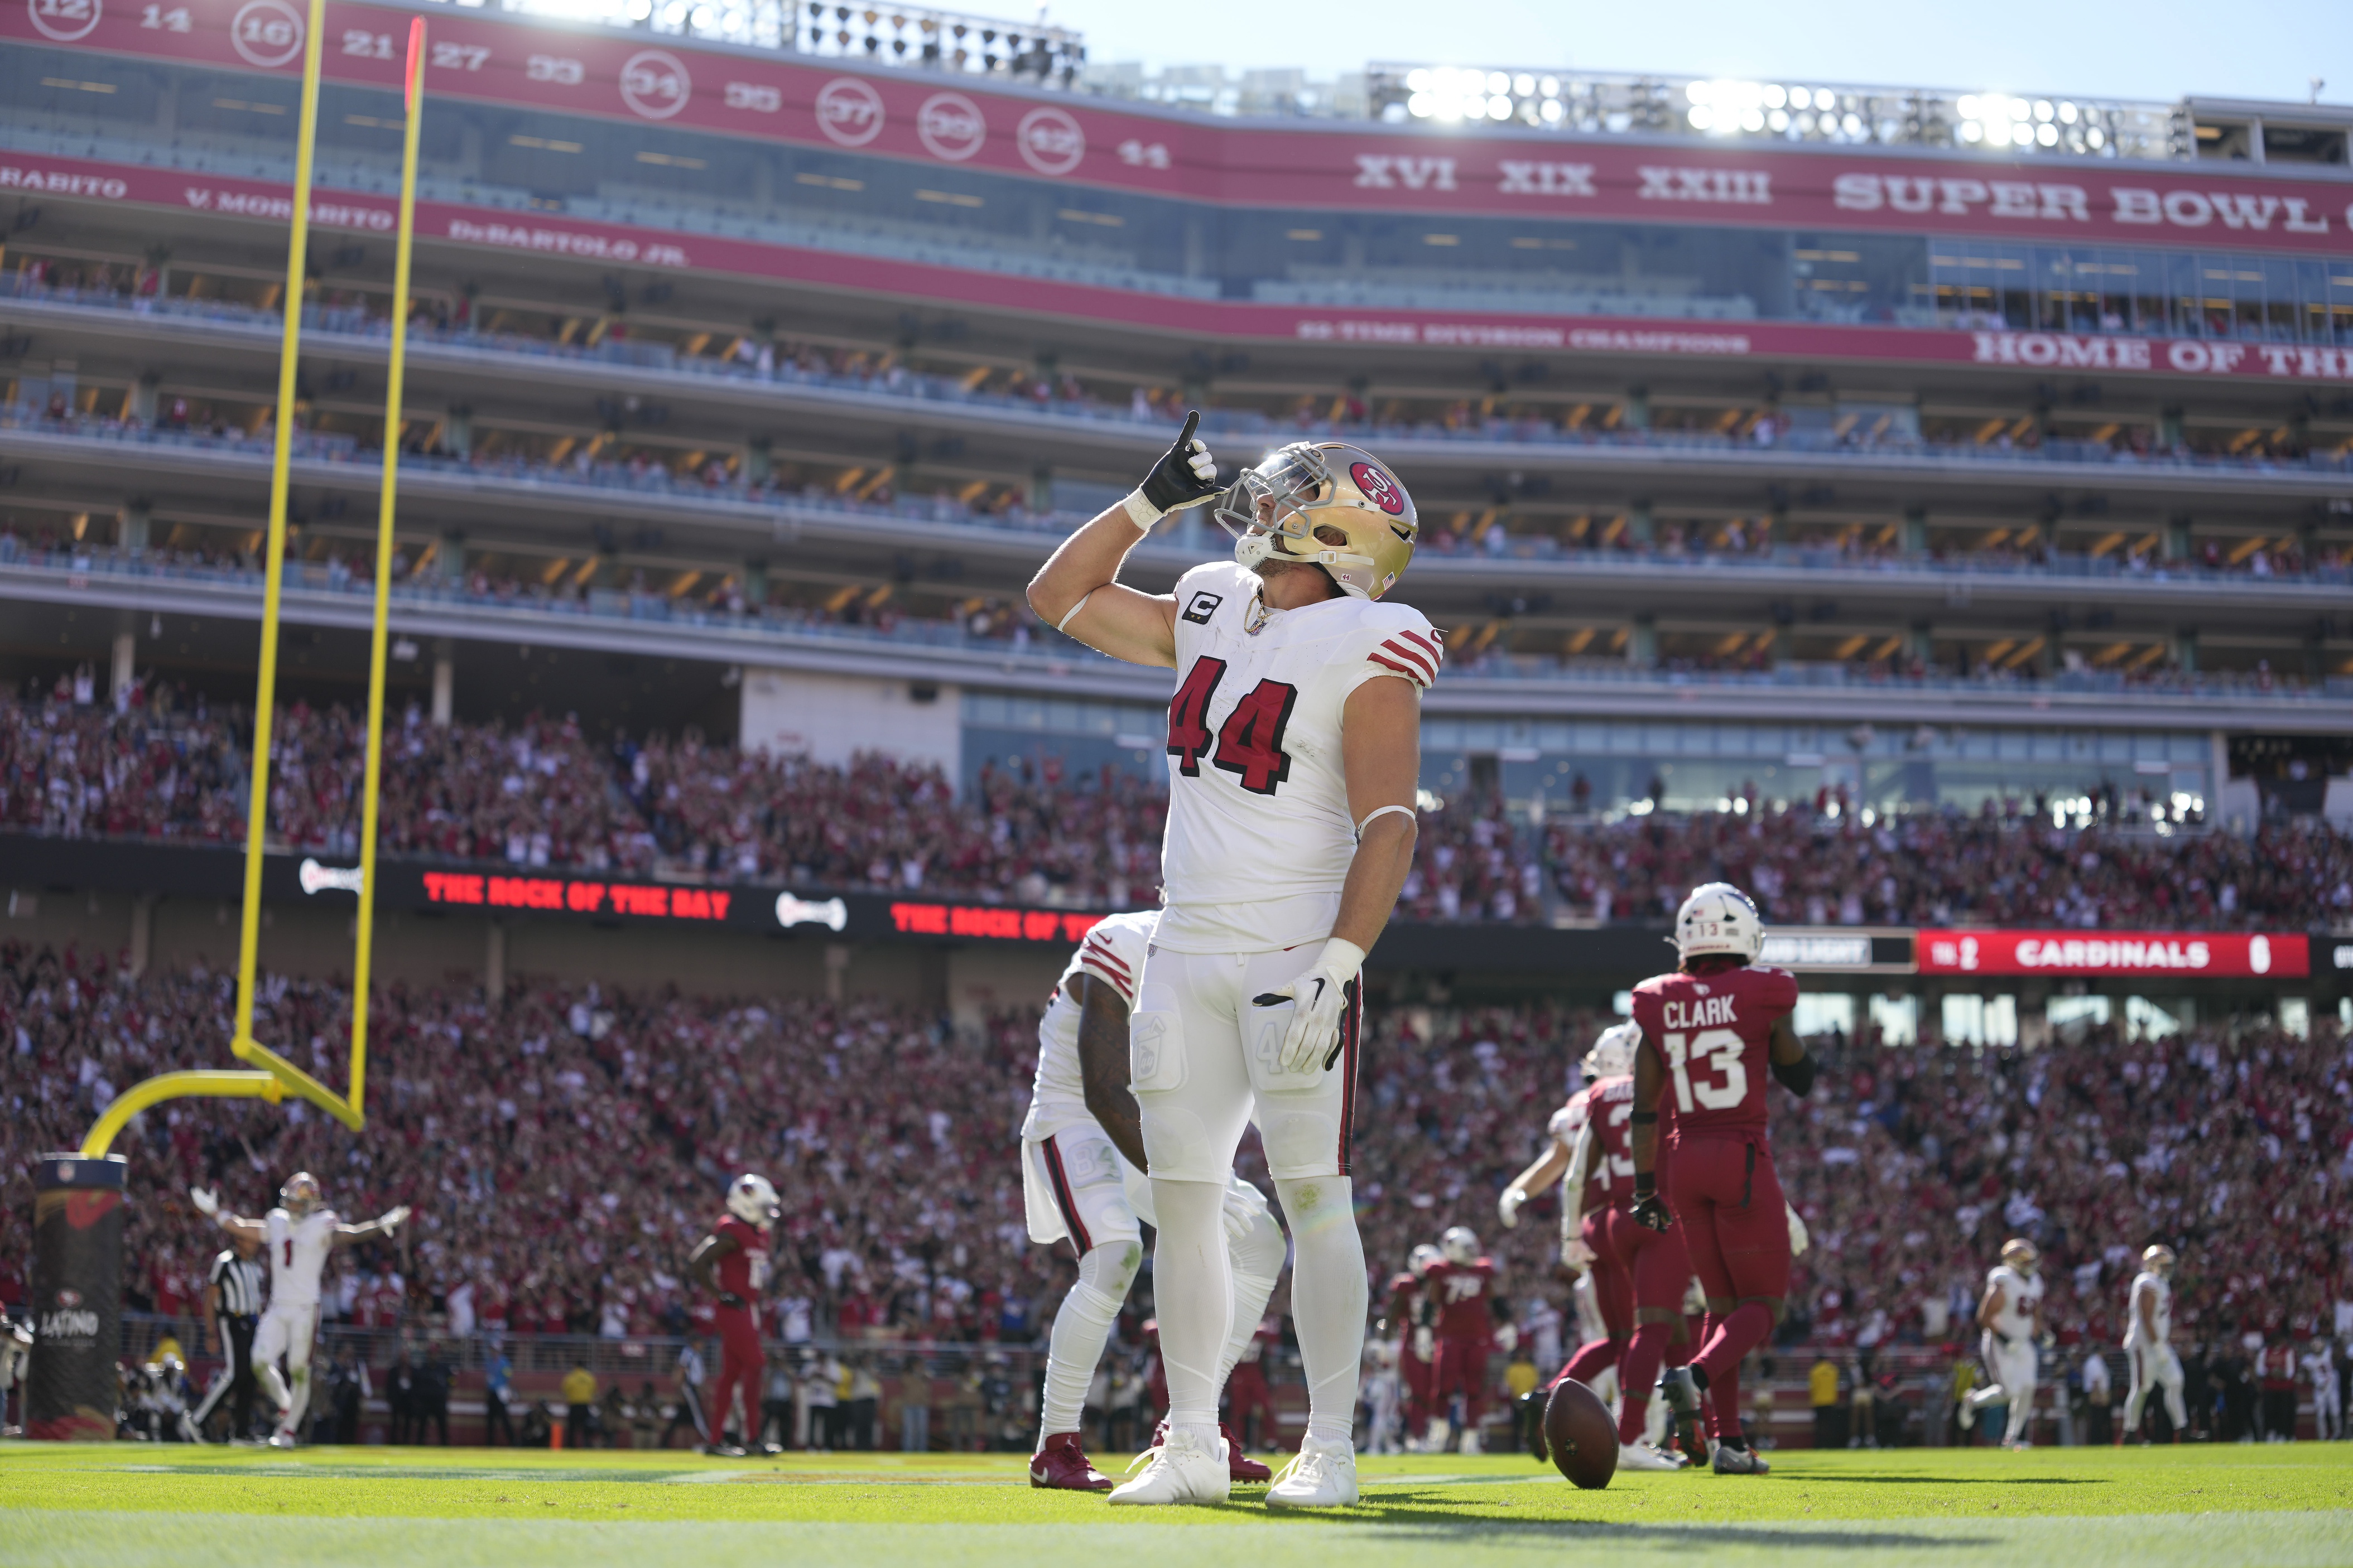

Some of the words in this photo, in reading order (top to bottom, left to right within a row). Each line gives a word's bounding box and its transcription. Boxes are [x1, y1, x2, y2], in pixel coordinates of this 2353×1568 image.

[37, 0, 93, 21] 12
[139, 3, 194, 33] 14
[242, 19, 294, 46] 16
[341, 28, 395, 60] 21
[431, 41, 490, 71] 27
[624, 67, 681, 99] 34
[823, 94, 875, 126] 37
[1354, 153, 1458, 191] XVI
[1498, 160, 1597, 197] XIX
[1637, 165, 1774, 205] XXIII
[1832, 172, 2091, 223] SUPER
[2110, 186, 2329, 235] BOWL
[1974, 331, 2152, 370] HOME
[2167, 340, 2245, 375] OF
[1188, 594, 1219, 616] C
[1166, 654, 1299, 797] 44
[422, 871, 484, 905] THE
[487, 876, 564, 910] ROCK
[567, 880, 606, 913] OF
[609, 884, 669, 917] THE
[671, 889, 731, 921] BAY
[891, 901, 949, 935] THE
[950, 906, 1022, 939] ROCK
[1024, 910, 1060, 942] OF
[1062, 913, 1110, 943] TH
[1700, 922, 1719, 938] 13
[1959, 935, 1980, 971] 2
[2014, 938, 2211, 969] CARDINALS
[1663, 993, 1738, 1030] CLARK
[1256, 1023, 1282, 1074] 4
[1662, 1027, 1749, 1114] 13
[283, 1237, 293, 1270] 1
[39, 1309, 99, 1339] LATINO
